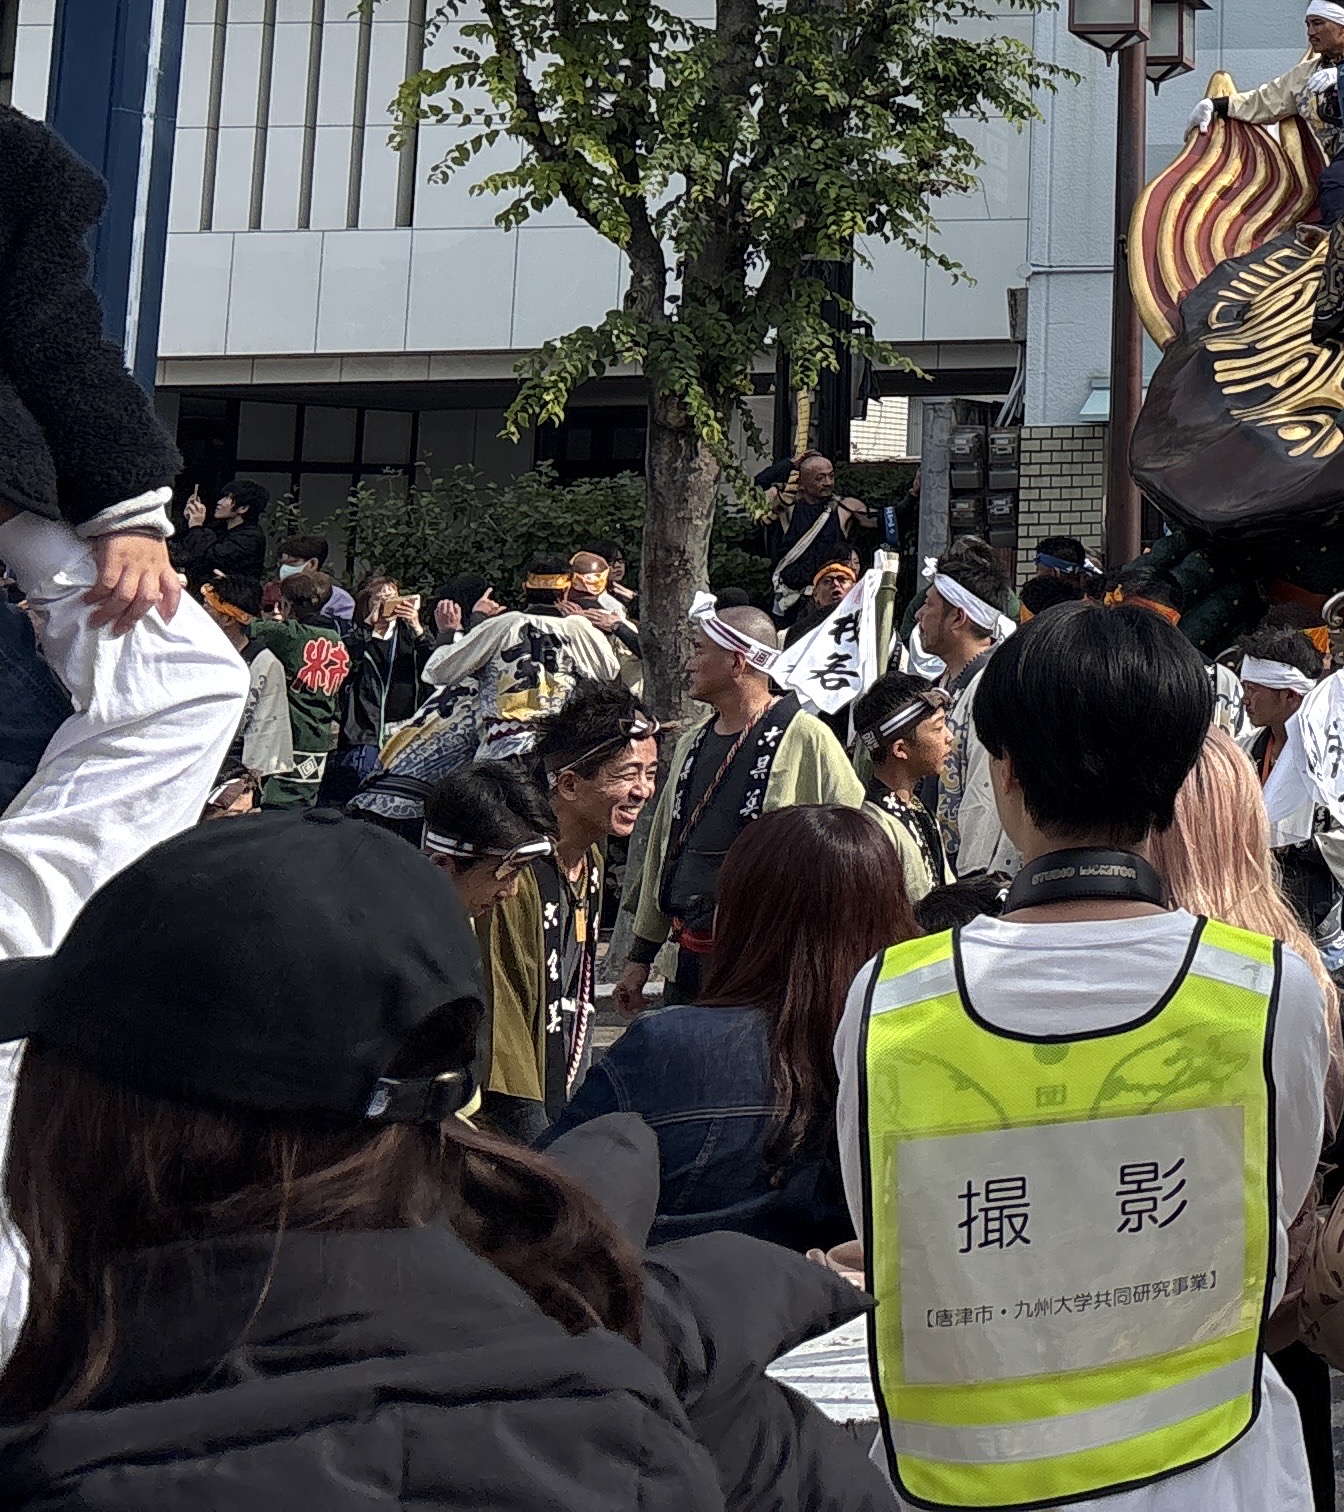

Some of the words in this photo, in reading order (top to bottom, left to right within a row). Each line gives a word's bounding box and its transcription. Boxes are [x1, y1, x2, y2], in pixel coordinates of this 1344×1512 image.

[925, 1269, 1219, 1330] 【唐津市・九州大学共同研究事業】
